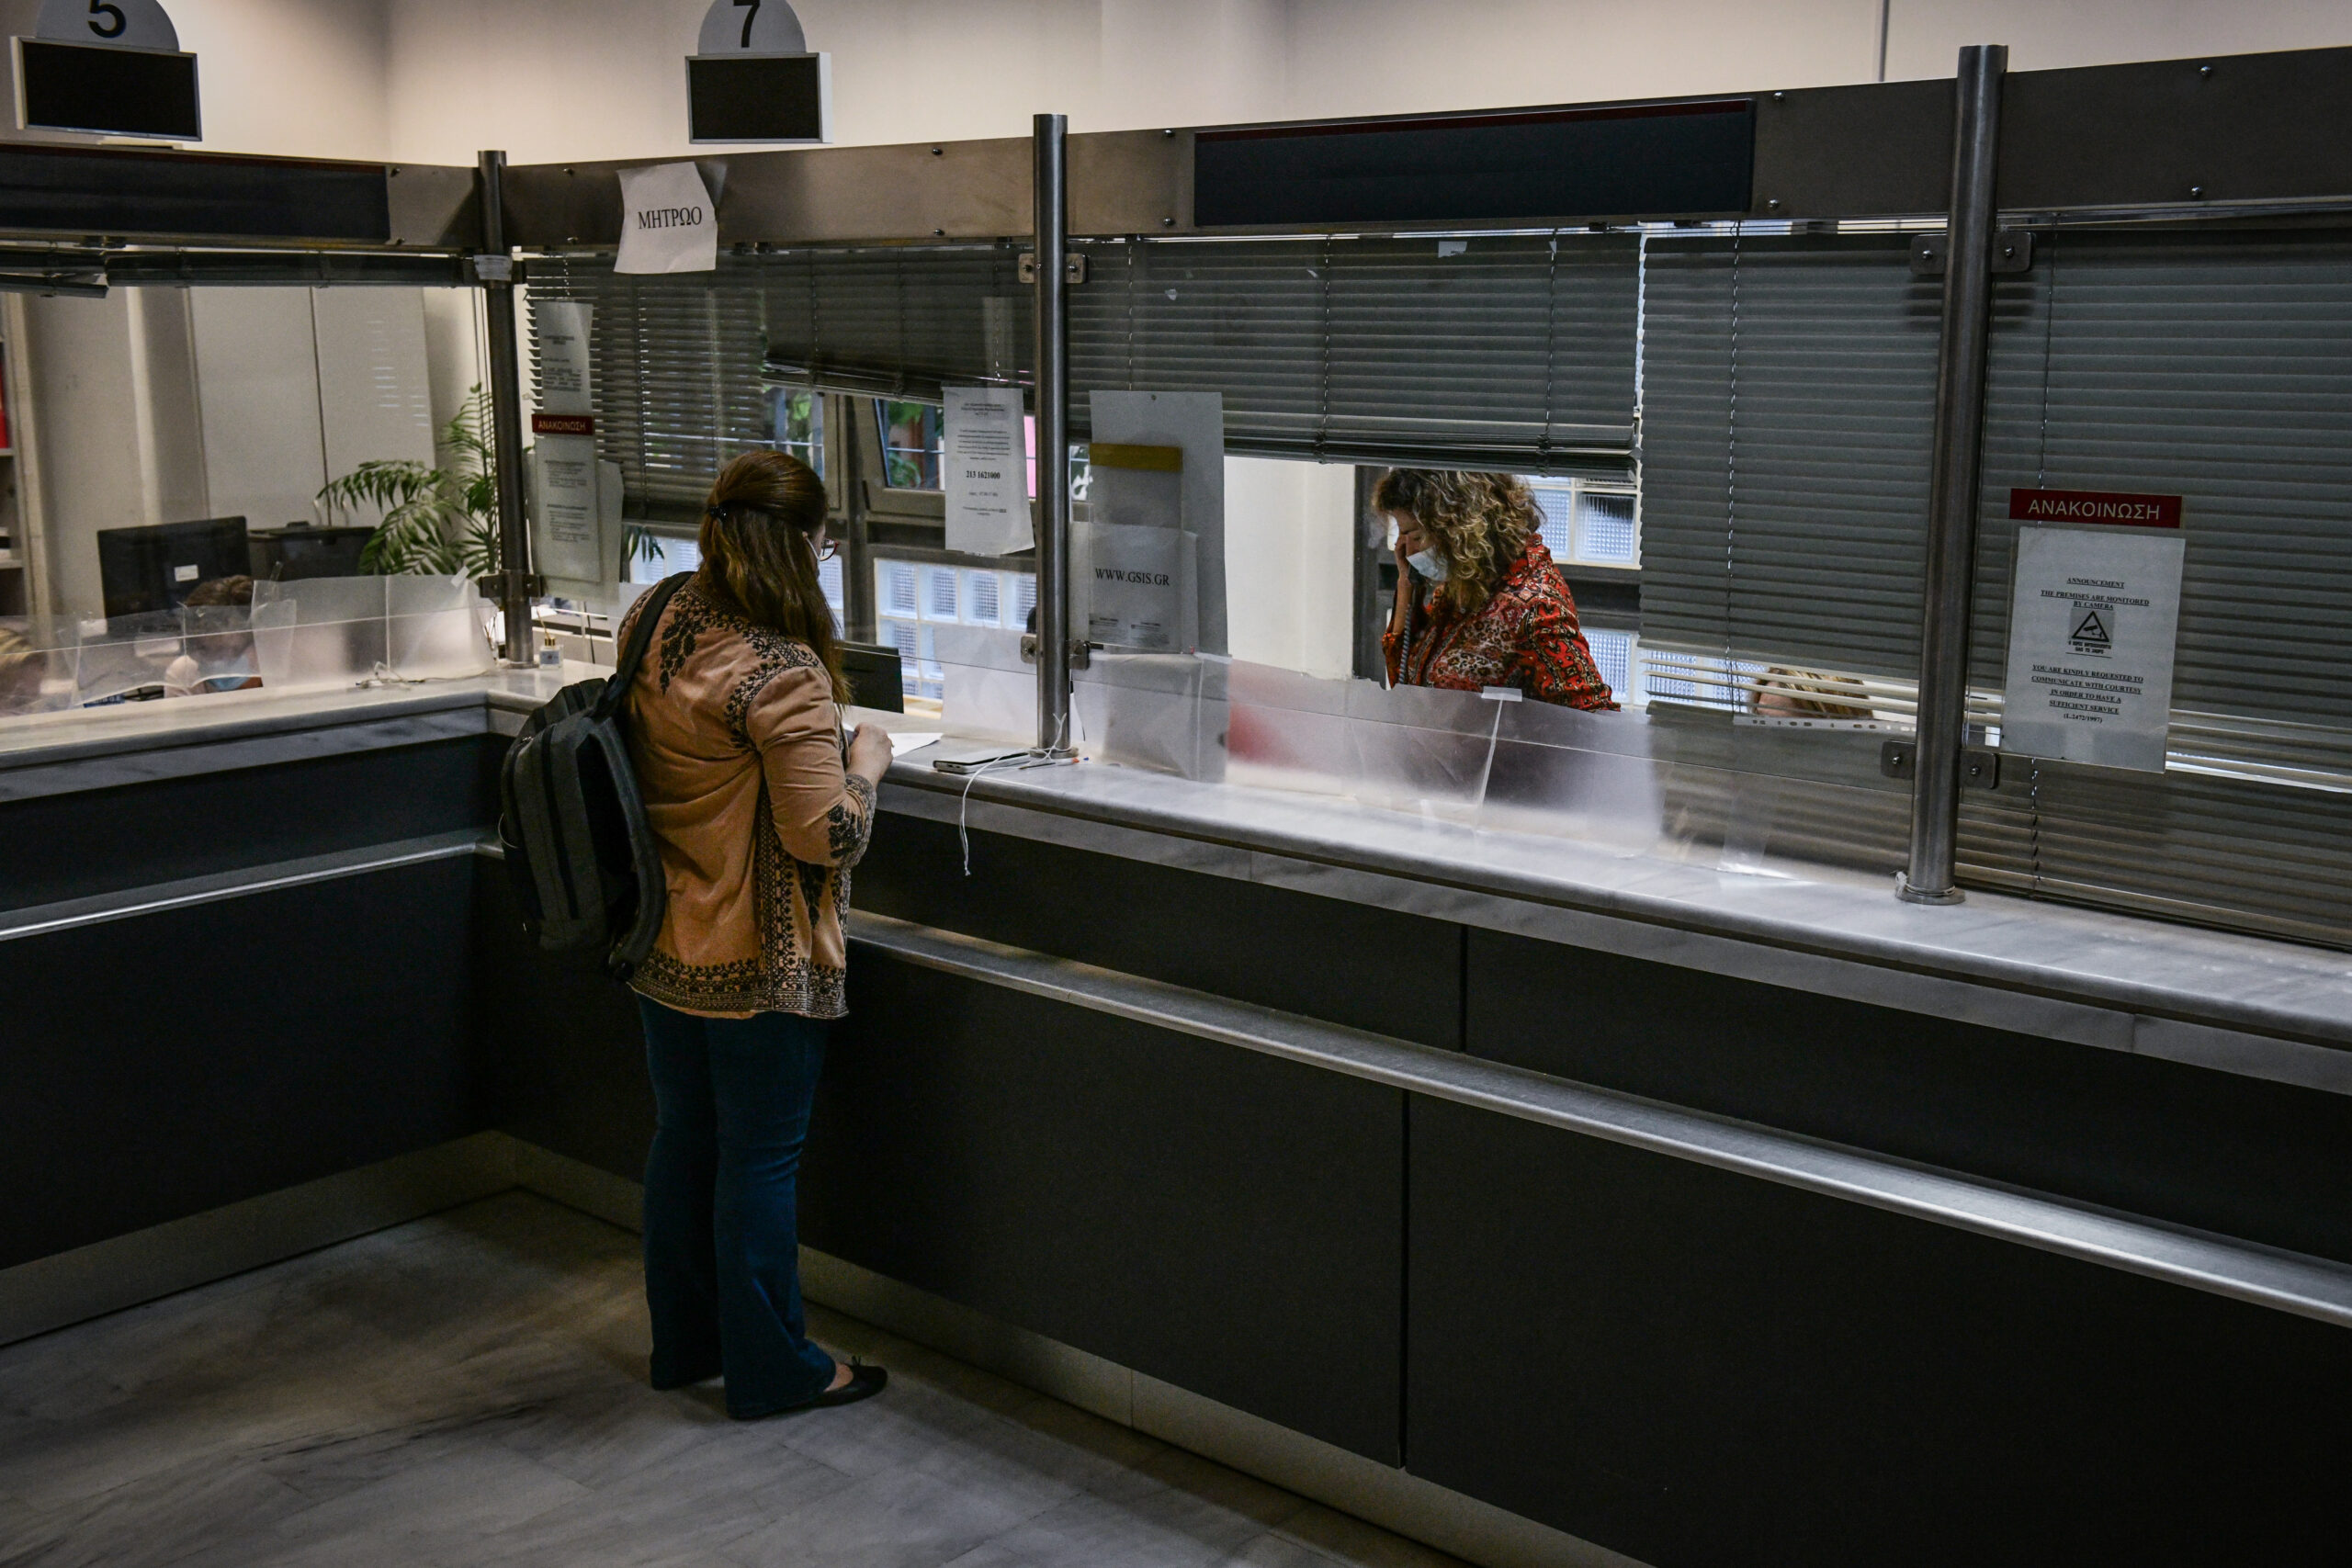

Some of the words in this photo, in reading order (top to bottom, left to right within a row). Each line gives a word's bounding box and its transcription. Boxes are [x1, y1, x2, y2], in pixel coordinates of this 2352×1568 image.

[87, 0, 127, 39] 5
[733, 0, 761, 48] 7
[638, 207, 702, 230] ΜΗΤΡΩΟ
[538, 421, 586, 431] ΑΝΑΚΟΙΝΩΣΗ
[966, 470, 977, 479] 213
[978, 470, 1001, 479] 1621000
[2028, 499, 2160, 520] ΑΝΑΚΟΙΝΩΣΗ
[1095, 568, 1170, 586] WWW.GSIS.GR
[2067, 577, 2124, 589] ANNOUNCEMENT
[2041, 589, 2054, 597] THE
[2056, 591, 2090, 600] PREMISES
[2106, 595, 2150, 606] MONITORED
[2084, 602, 2114, 610] CAMERA
[2032, 664, 2047, 672] YOU
[2063, 668, 2089, 676] KINDLY
[2091, 671, 2132, 682] REQUESTED
[2031, 675, 2083, 687] COMMUNICATE
[2105, 685, 2143, 694] COURTESY
[2059, 690, 2085, 698] ORDER
[2096, 694, 2116, 703] HAVE
[2049, 700, 2089, 711] SUFFICIENT
[2090, 705, 2120, 715] SERVICE
